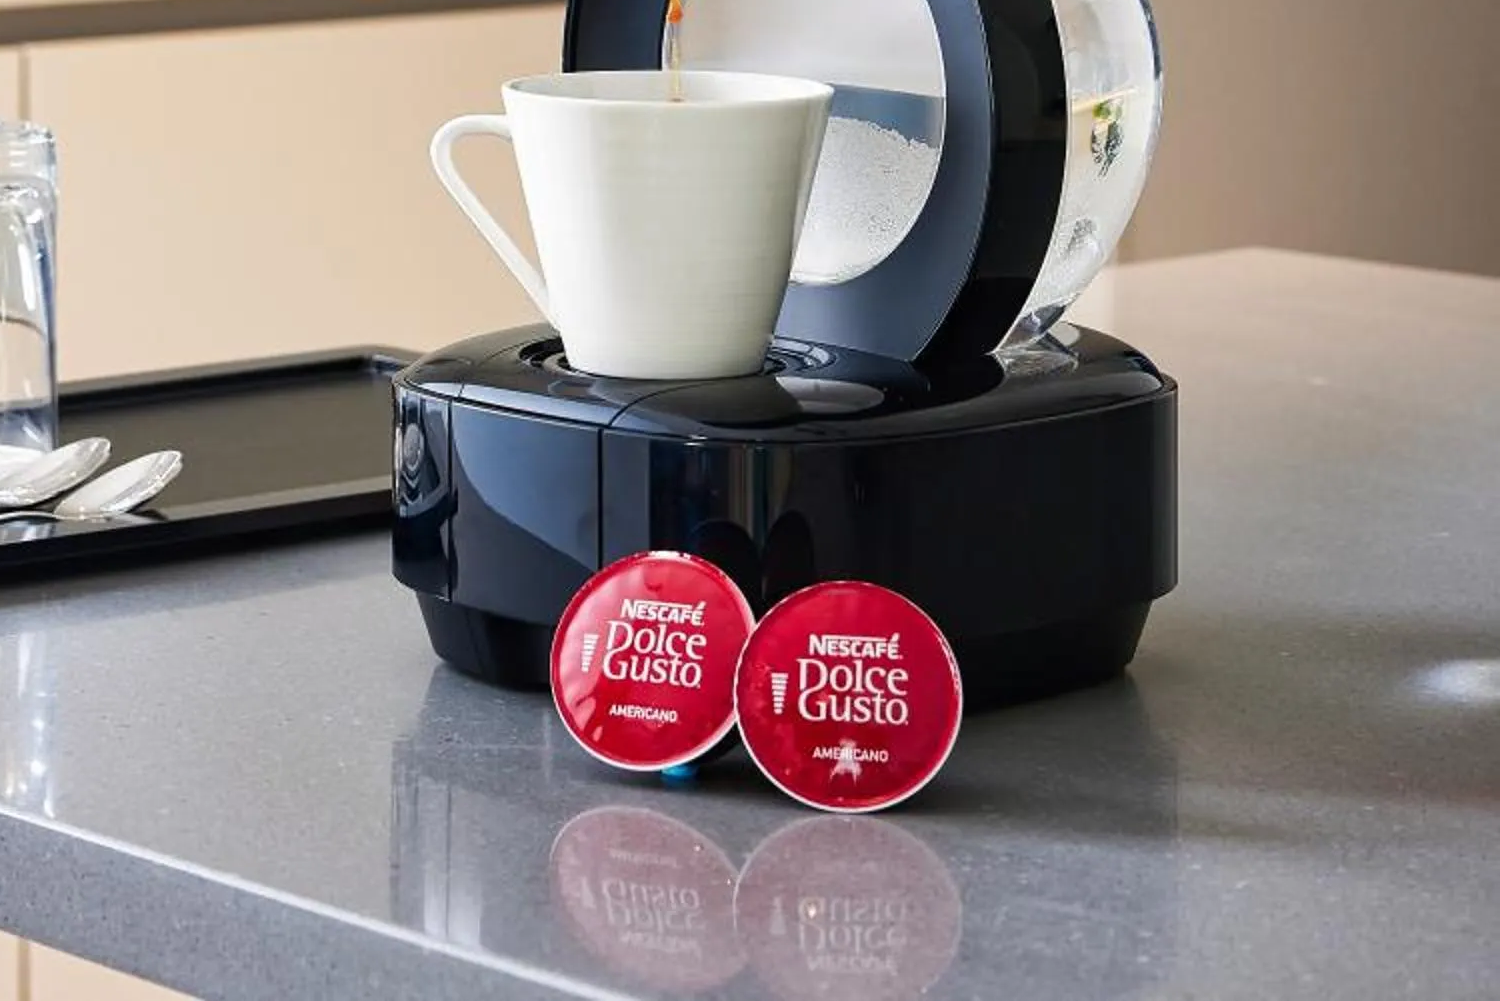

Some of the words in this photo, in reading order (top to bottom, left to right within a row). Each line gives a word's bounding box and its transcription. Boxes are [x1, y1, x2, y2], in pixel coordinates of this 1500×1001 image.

[621, 599, 706, 626] NESCAFÉ
[605, 620, 707, 660] Dolce
[808, 632, 901, 659] NESCAFÉ
[603, 650, 701, 688] Gusto
[796, 658, 908, 695] Dolce
[609, 703, 678, 723] AMERICANO
[798, 690, 908, 725] Gusto
[812, 746, 889, 763] AMERICANO
